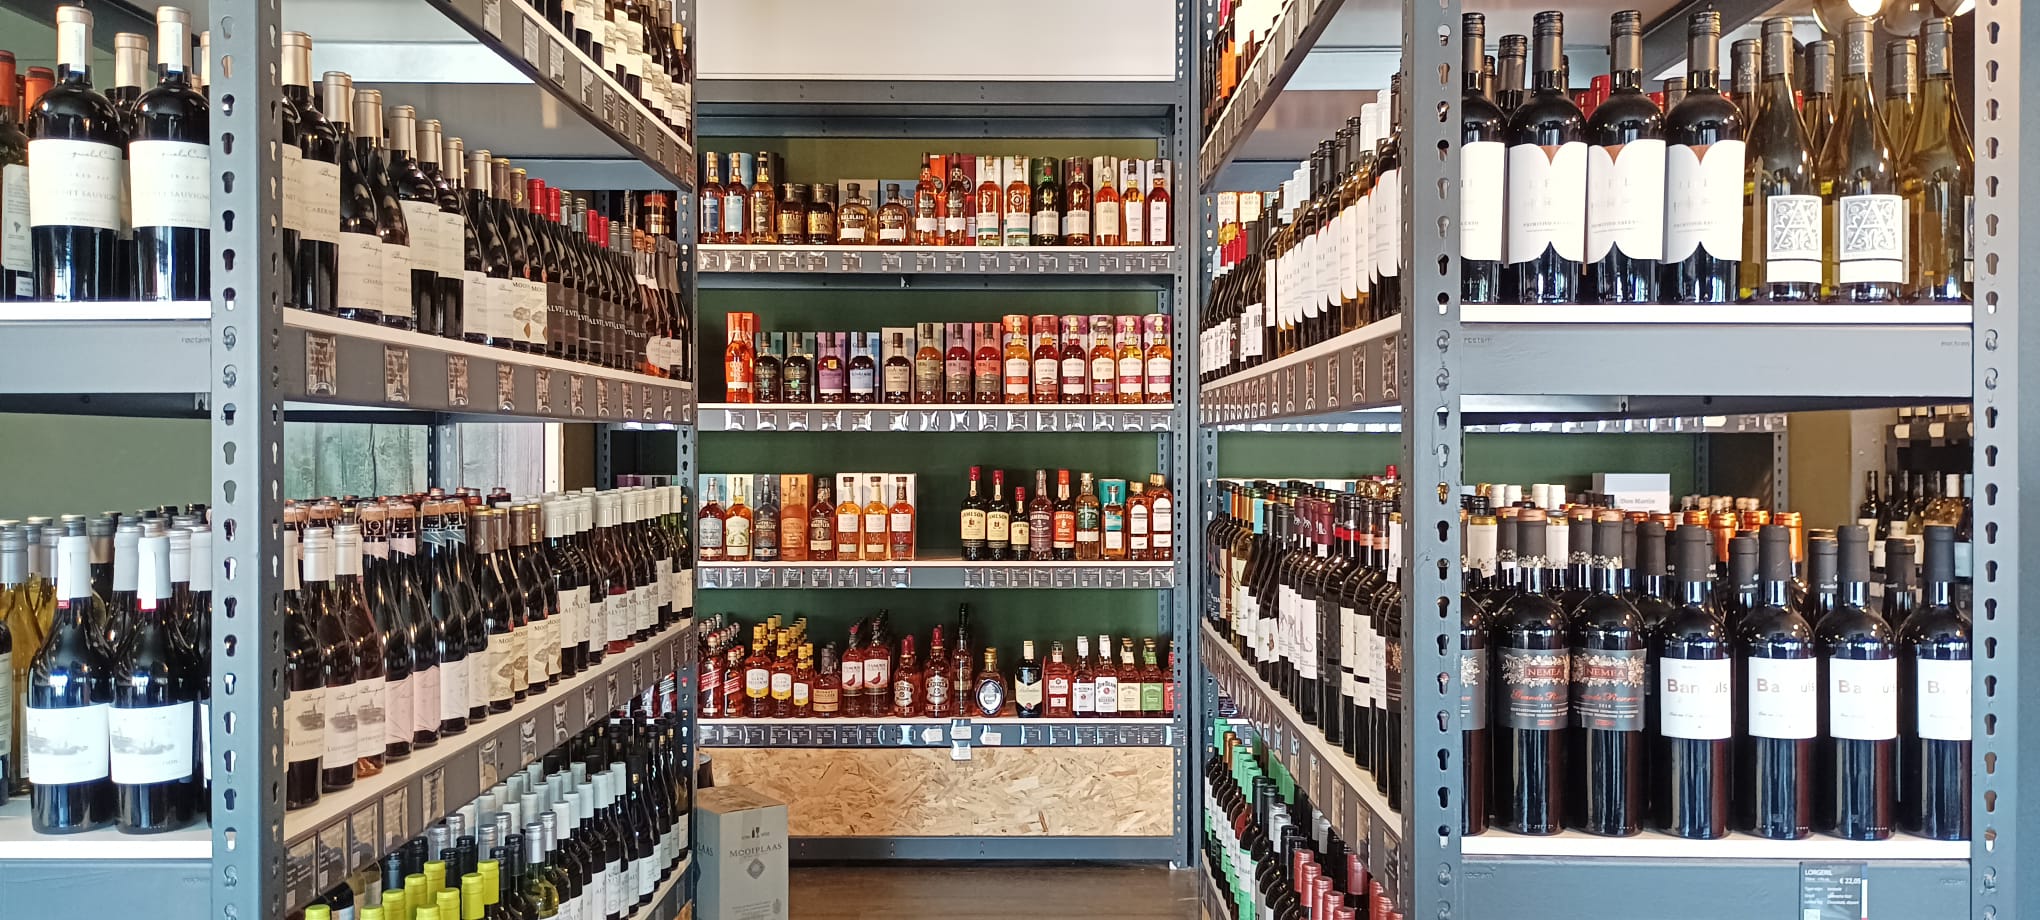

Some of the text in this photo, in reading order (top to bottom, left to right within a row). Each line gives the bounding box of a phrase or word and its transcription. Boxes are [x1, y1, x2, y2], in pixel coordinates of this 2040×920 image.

[1527, 667, 1562, 677] NEMEA
[1585, 667, 1625, 678] NEMEA
[729, 843, 783, 858] MOOIPLAAS
